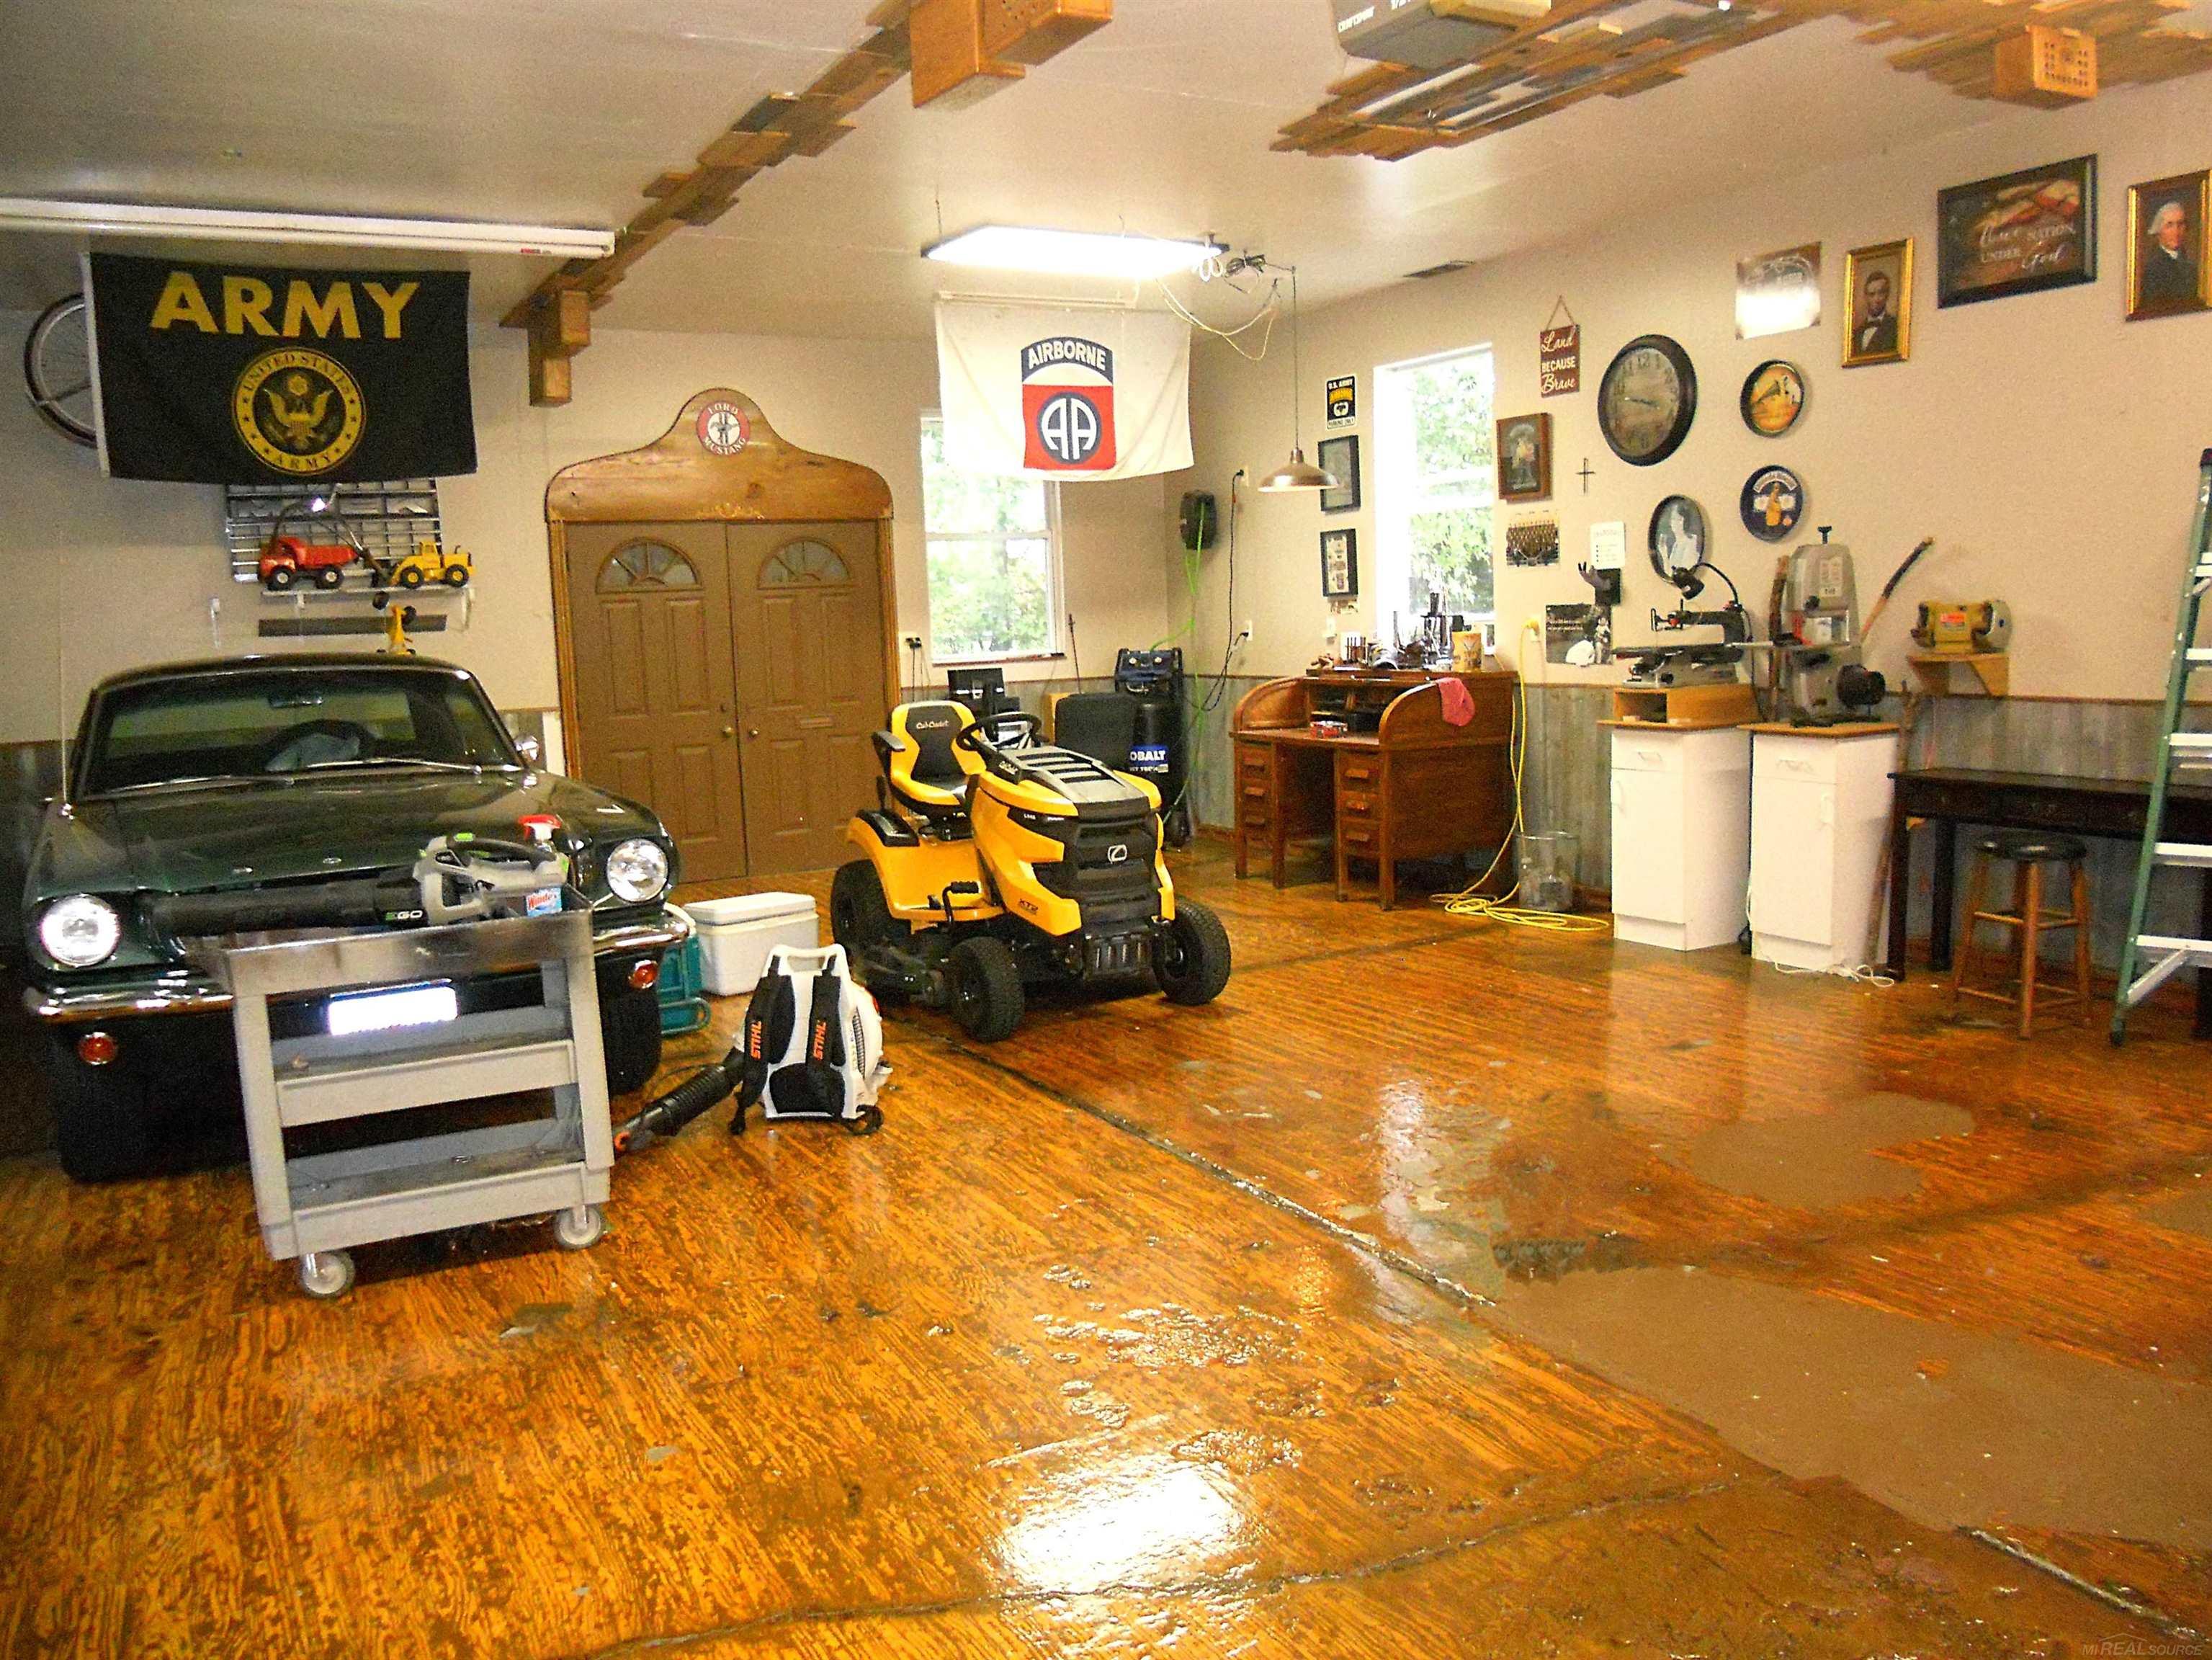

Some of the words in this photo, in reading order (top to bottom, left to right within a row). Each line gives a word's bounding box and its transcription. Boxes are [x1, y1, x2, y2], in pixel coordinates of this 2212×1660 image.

[149, 271, 420, 339] ARMY
[1028, 341, 1106, 372] AIRBORNE
[1542, 356, 1575, 372] BECAUSE
[1541, 374, 1575, 393] Brave
[707, 403, 739, 415] FORD
[1041, 398, 1097, 460] AA
[703, 436, 746, 456] MUSTANG
[1129, 750, 1166, 762] OBALT
[386, 910, 423, 920] EGO
[751, 1020, 762, 1060] STIHL
[812, 1020, 827, 1061] STIHL
